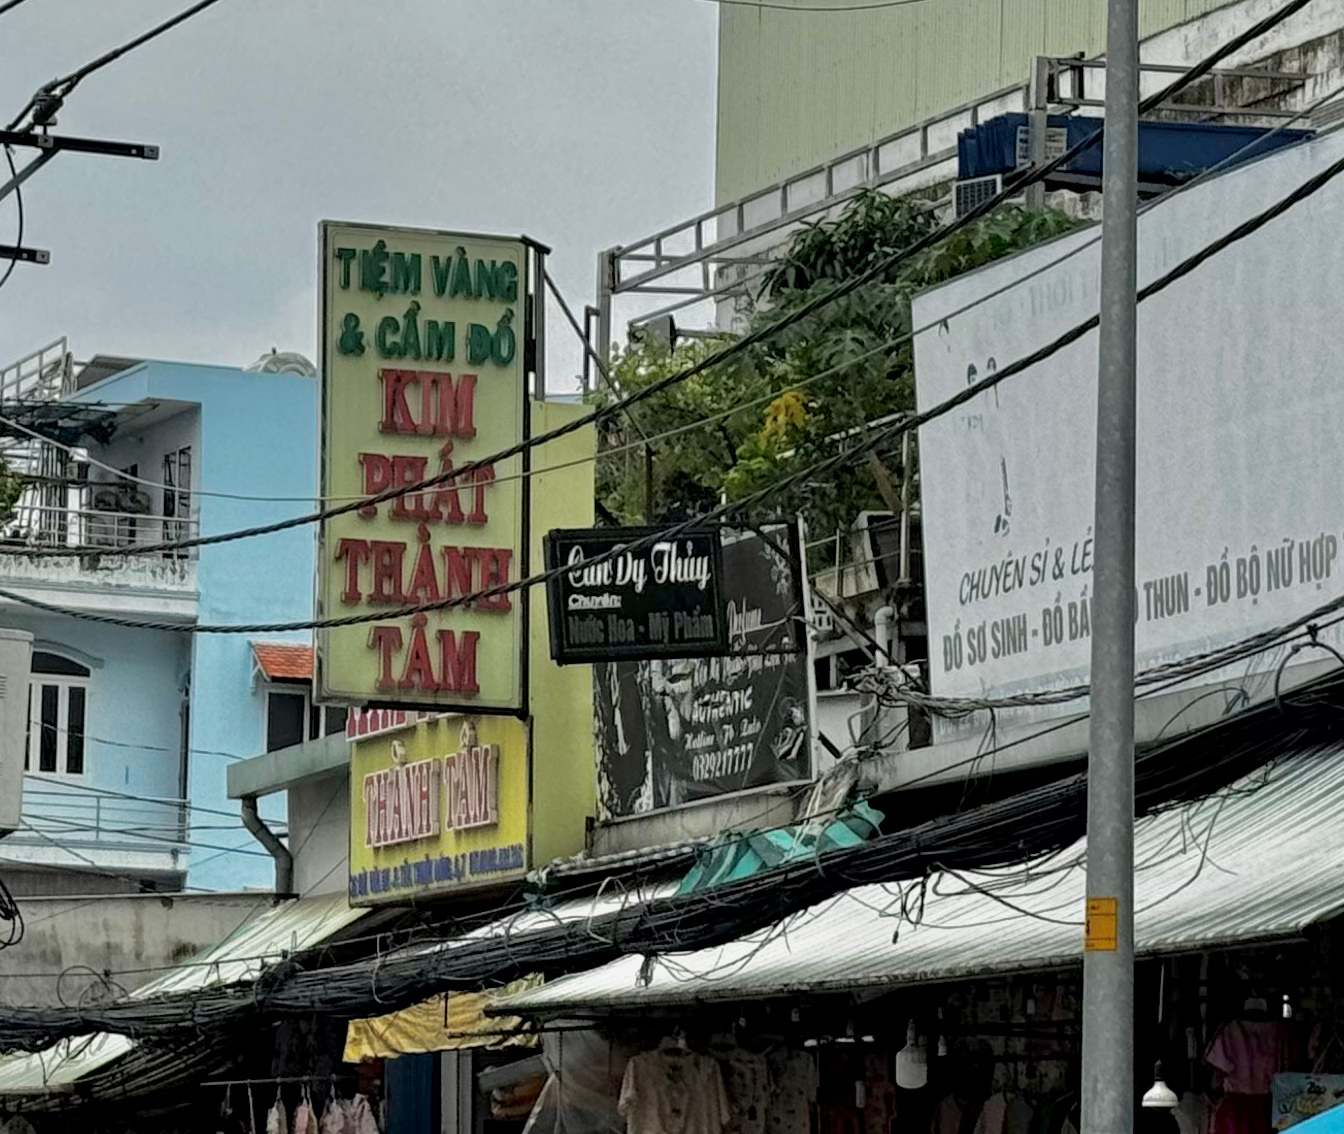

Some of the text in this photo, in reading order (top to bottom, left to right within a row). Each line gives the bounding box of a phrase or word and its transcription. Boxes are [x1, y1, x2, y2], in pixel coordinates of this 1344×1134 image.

[336, 239, 518, 302] TIỆM VÀNG
[338, 313, 366, 356] &
[378, 368, 478, 438] KIM
[358, 439, 496, 525] PHÁT
[335, 522, 513, 614] THÀNH
[959, 550, 1027, 606] CHUYÊN
[1052, 547, 1065, 582] &
[1144, 571, 1189, 622] THUN
[1206, 546, 1231, 607] ĐỒ
[1236, 545, 1261, 606] BỘ
[1266, 538, 1295, 593] NỮ
[1299, 532, 1337, 591] HỢP
[367, 612, 481, 693] TÂM
[608, 614, 635, 642] Hoa
[943, 617, 963, 673] ĐỒ
[967, 620, 987, 667] SƠ
[991, 611, 1028, 660] SINH
[1068, 584, 1093, 642] BẦ
[363, 721, 500, 848] THÀNH TÂM
